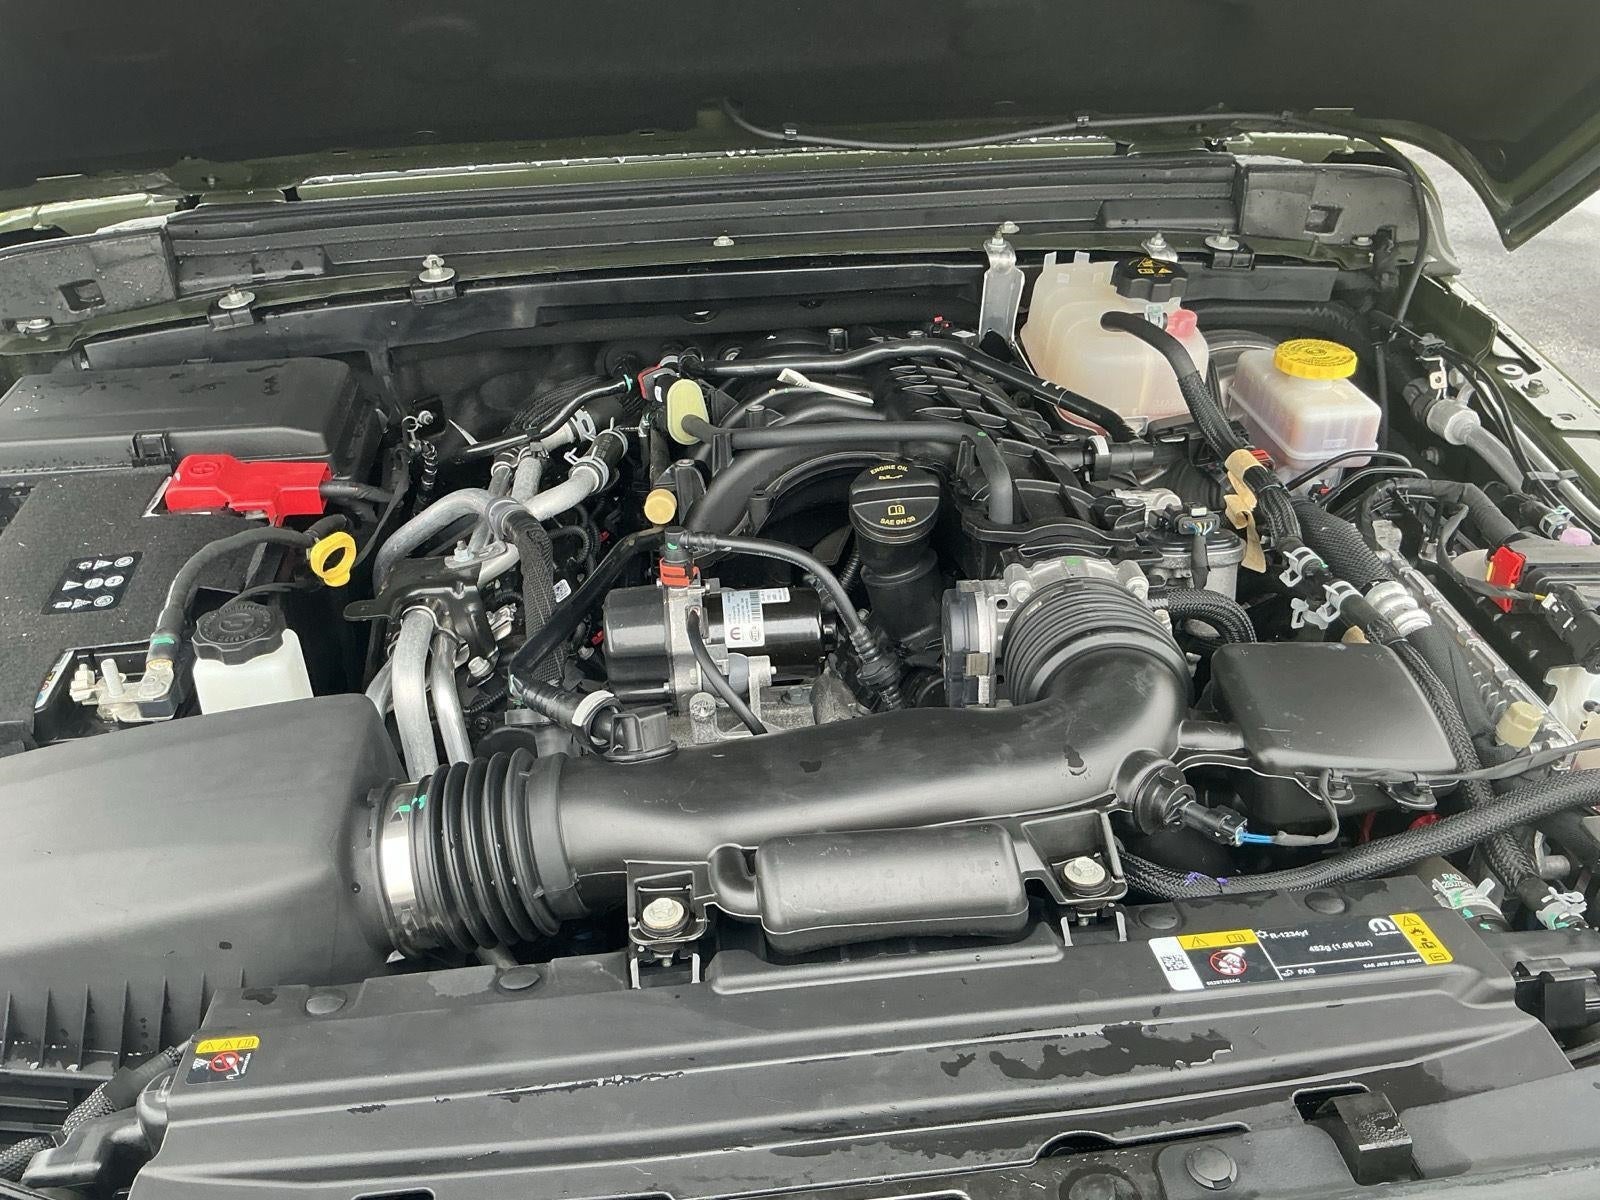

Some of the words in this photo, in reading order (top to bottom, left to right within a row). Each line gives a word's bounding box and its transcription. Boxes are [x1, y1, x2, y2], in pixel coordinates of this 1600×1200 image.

[870, 465, 895, 475] ENGINE
[897, 464, 909, 472] OIL
[1269, 930, 1309, 939] R-1234yf
[1355, 939, 1374, 948] lbs)
